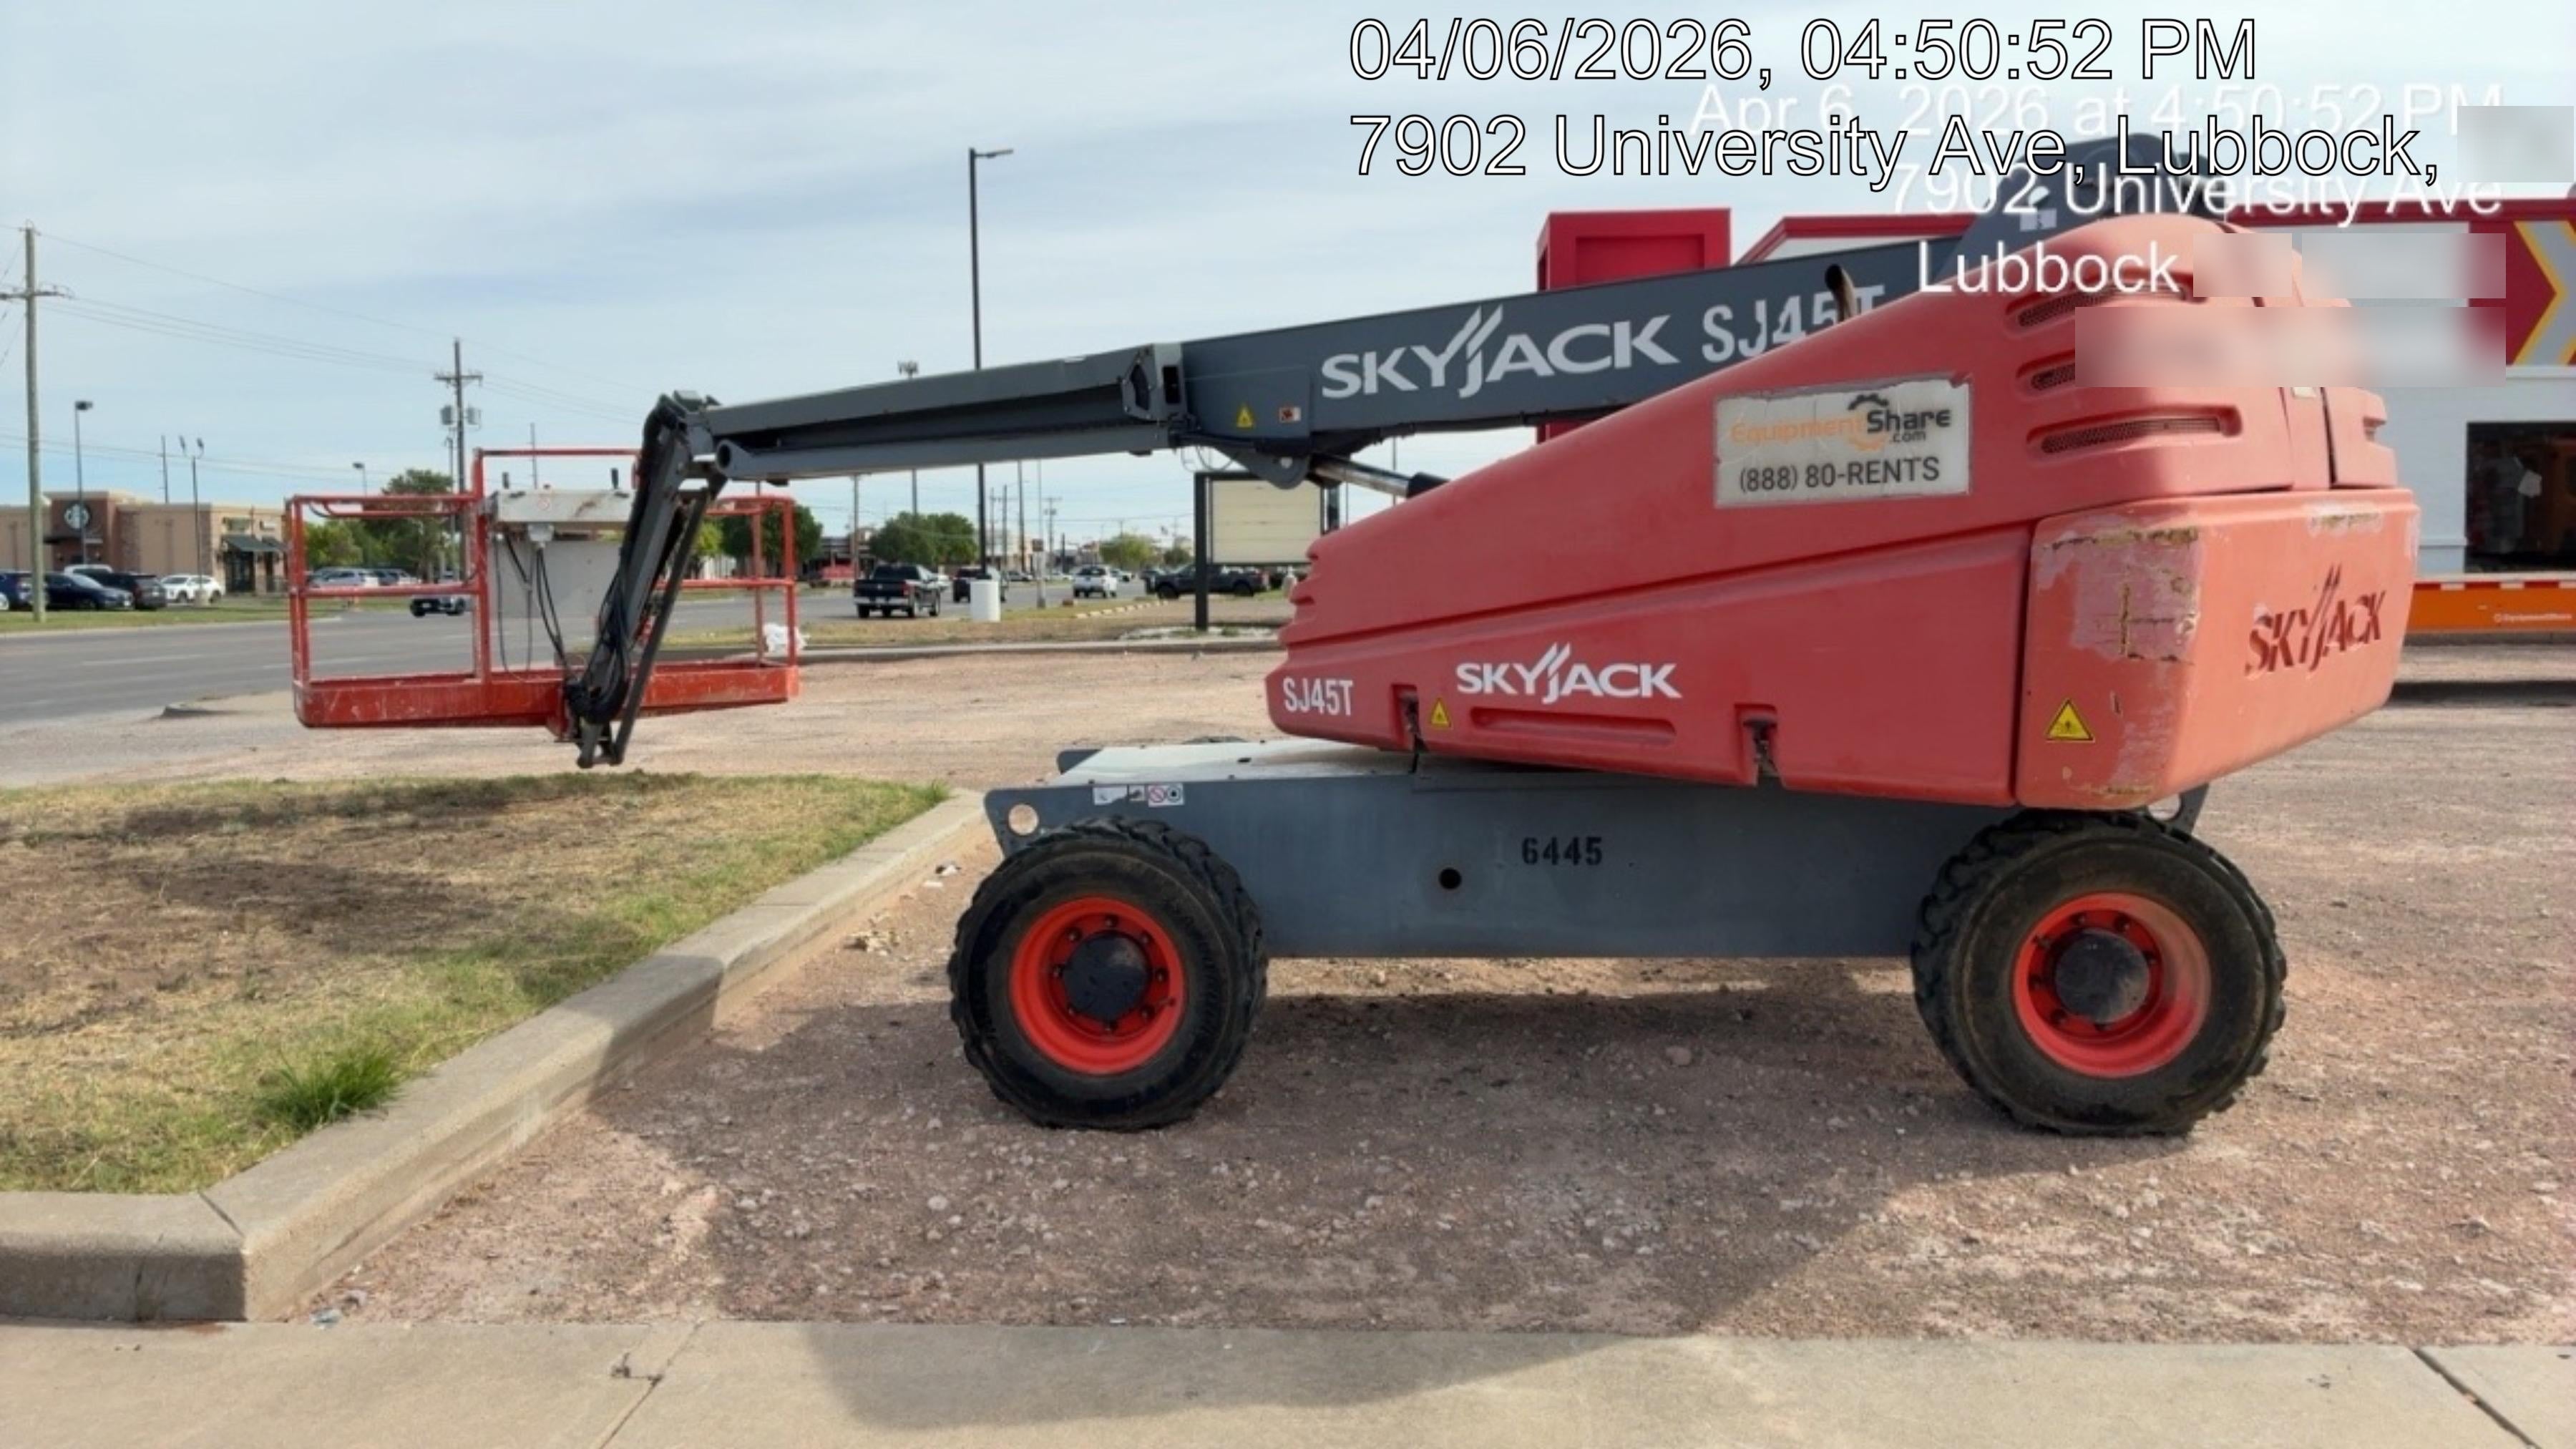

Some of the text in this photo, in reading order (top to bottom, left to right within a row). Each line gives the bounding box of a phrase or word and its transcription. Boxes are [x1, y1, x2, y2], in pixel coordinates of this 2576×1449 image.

[1321, 304, 1679, 399] SKYJACK
[1740, 457, 1940, 494] (888) 80-RENTS
[2245, 562, 2386, 675] SKYJACK
[1283, 676, 1353, 716] SJ45T
[1456, 643, 1682, 705] SKYJACK
[1521, 836, 1604, 866] 6445
